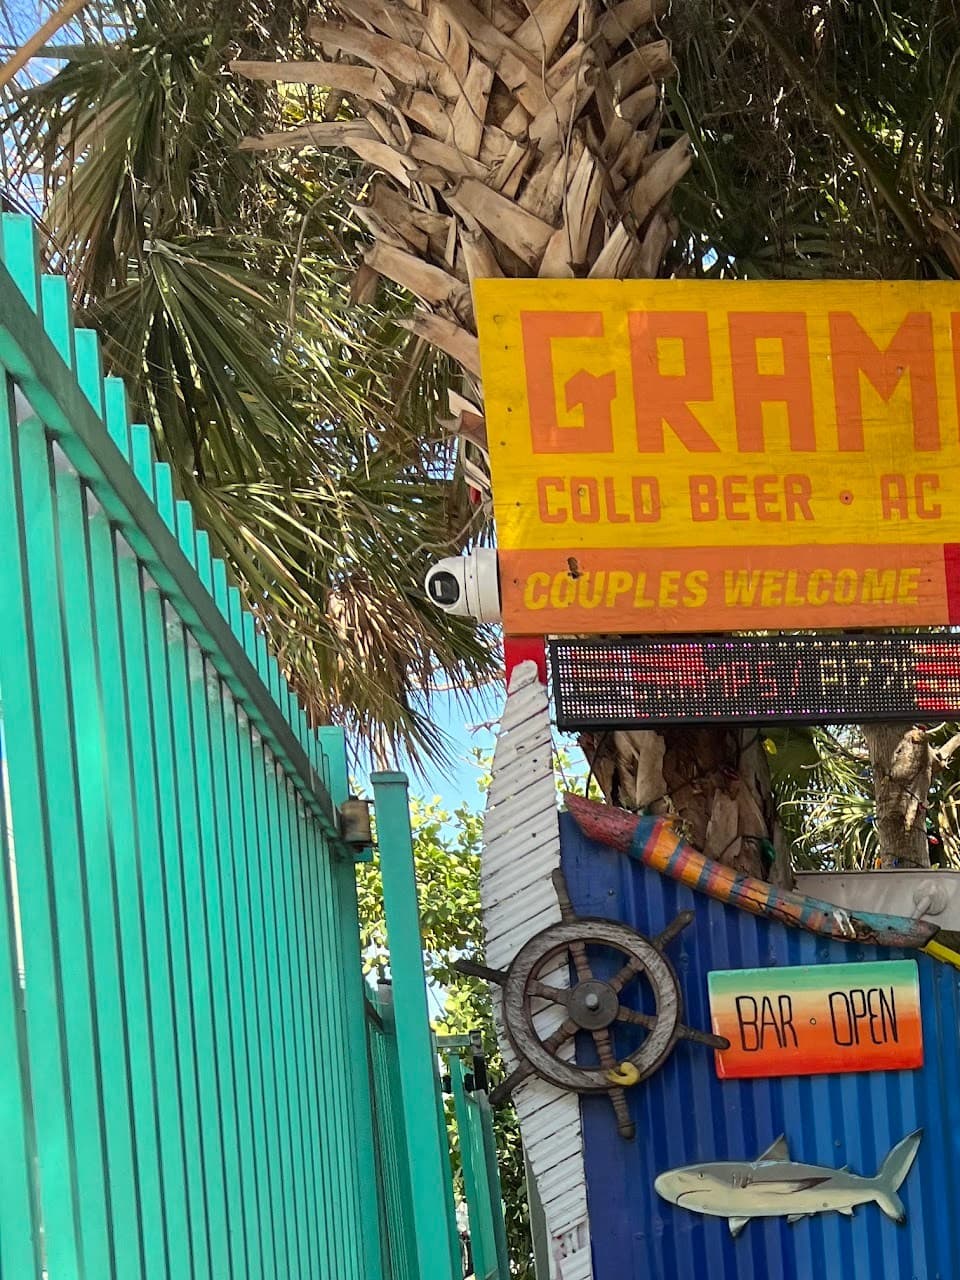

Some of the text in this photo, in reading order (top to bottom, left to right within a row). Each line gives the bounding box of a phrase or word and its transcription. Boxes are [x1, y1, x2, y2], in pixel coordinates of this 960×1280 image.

[537, 475, 662, 524] COLD
[688, 473, 816, 522] BEER
[879, 473, 942, 520] AC
[523, 567, 922, 610] COUPLES WELCOME
[735, 986, 900, 1052] BAR OPEN
